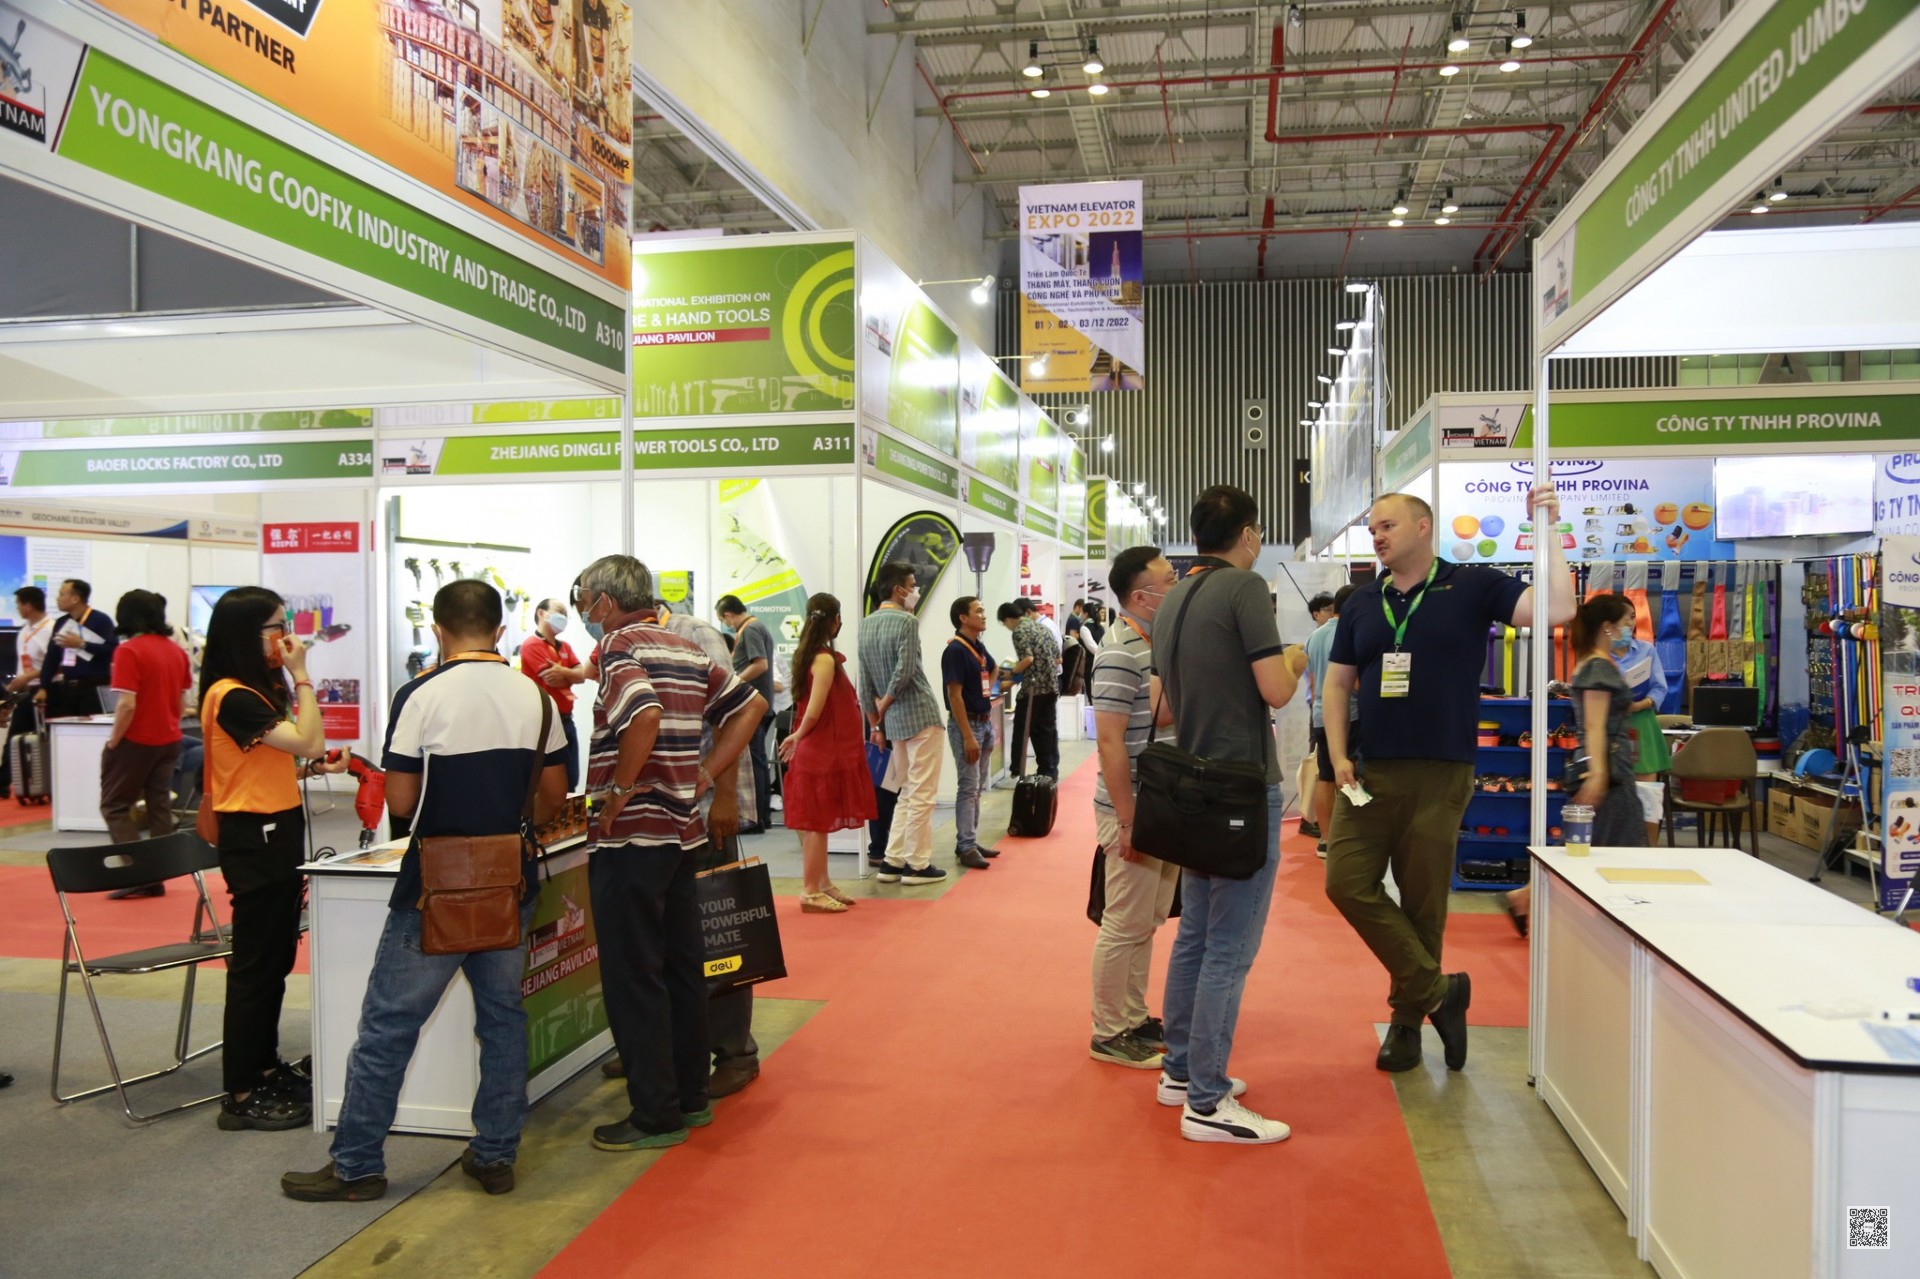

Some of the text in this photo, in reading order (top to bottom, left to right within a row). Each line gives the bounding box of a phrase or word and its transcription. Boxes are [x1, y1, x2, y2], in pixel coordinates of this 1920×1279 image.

[199, 0, 296, 75] PARTNER
[1658, 154, 1675, 197] TY
[1676, 113, 1716, 179] TNHH
[1720, 48, 1784, 139] UNITED
[89, 84, 587, 333] YONGKANG COOFIX INDUSTRY AND TRADE CO., LTD
[1027, 200, 1136, 214] VIETNAM ELEVATOR
[1028, 211, 1135, 230] EXPO 2022
[691, 294, 751, 305] EXHIBITION
[754, 292, 770, 301] ON
[651, 313, 661, 326] &
[666, 311, 711, 326] HAND
[715, 308, 770, 323] TOOLS
[1035, 321, 1044, 330] 01
[1059, 320, 1068, 328] 02
[1080, 319, 1089, 328] 03
[596, 321, 623, 352] A310
[666, 331, 715, 343] PAVILION
[1656, 412, 1882, 432] CÔNG TY TNHH PROVINA
[490, 437, 780, 461] ZHEJIANG DINGLI PWER TOOLS CO., LTD
[813, 437, 850, 451] A311
[87, 454, 283, 472] BAOER LOCKS FACTORY CO., LTD
[338, 452, 373, 466] A334
[1465, 479, 1512, 493] CÔNG
[1516, 481, 1533, 492] TY
[1582, 479, 1649, 492] PROVINA
[1591, 493, 1630, 502] LIMITED
[1890, 497, 1903, 519] TY
[73, 515, 106, 526] ELEVATOR
[108, 519, 130, 528] VALLEY
[1889, 570, 1920, 583] CÔNG
[750, 605, 792, 613] PROMOTION
[698, 897, 736, 915] YOUR
[701, 905, 771, 932] POWERFUL
[559, 928, 585, 951] VIETNAM
[703, 929, 742, 948] MATE
[560, 944, 598, 977] PAVILION
[710, 960, 733, 973] deli
